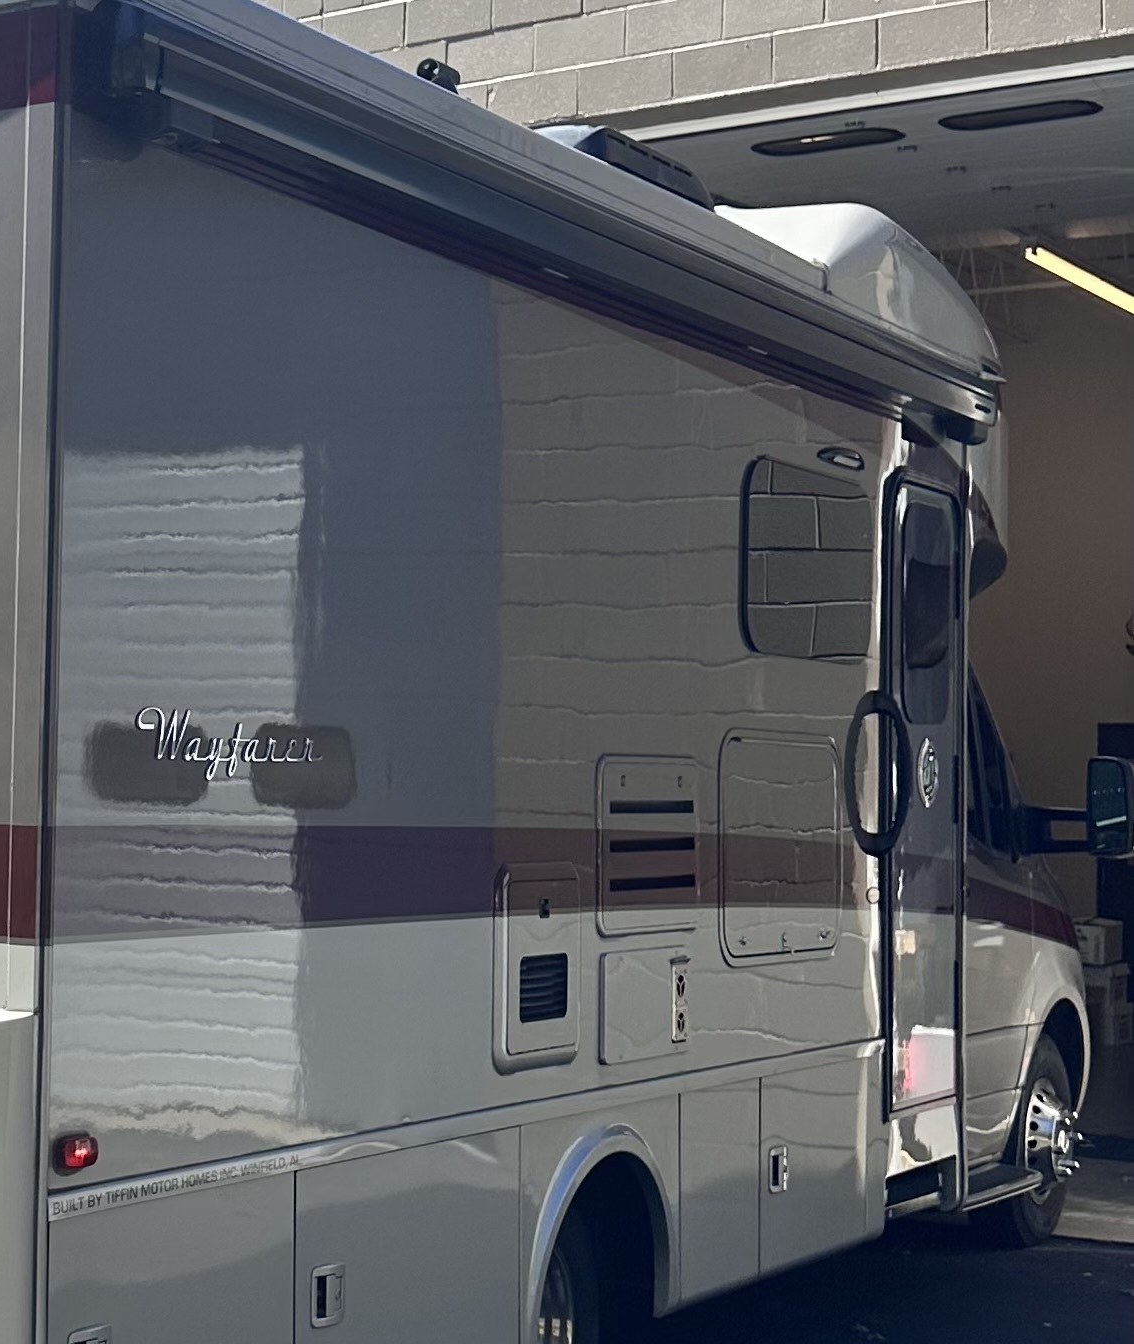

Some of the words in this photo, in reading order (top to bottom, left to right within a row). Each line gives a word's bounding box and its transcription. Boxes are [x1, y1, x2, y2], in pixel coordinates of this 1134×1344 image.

[136, 706, 322, 781] Wayfarer
[52, 1197, 85, 1216] BUILT
[87, 1193, 102, 1208] BY
[105, 1186, 138, 1205] TIFFIN
[140, 1177, 179, 1196] MOTOR
[181, 1169, 219, 1189] HOMES
